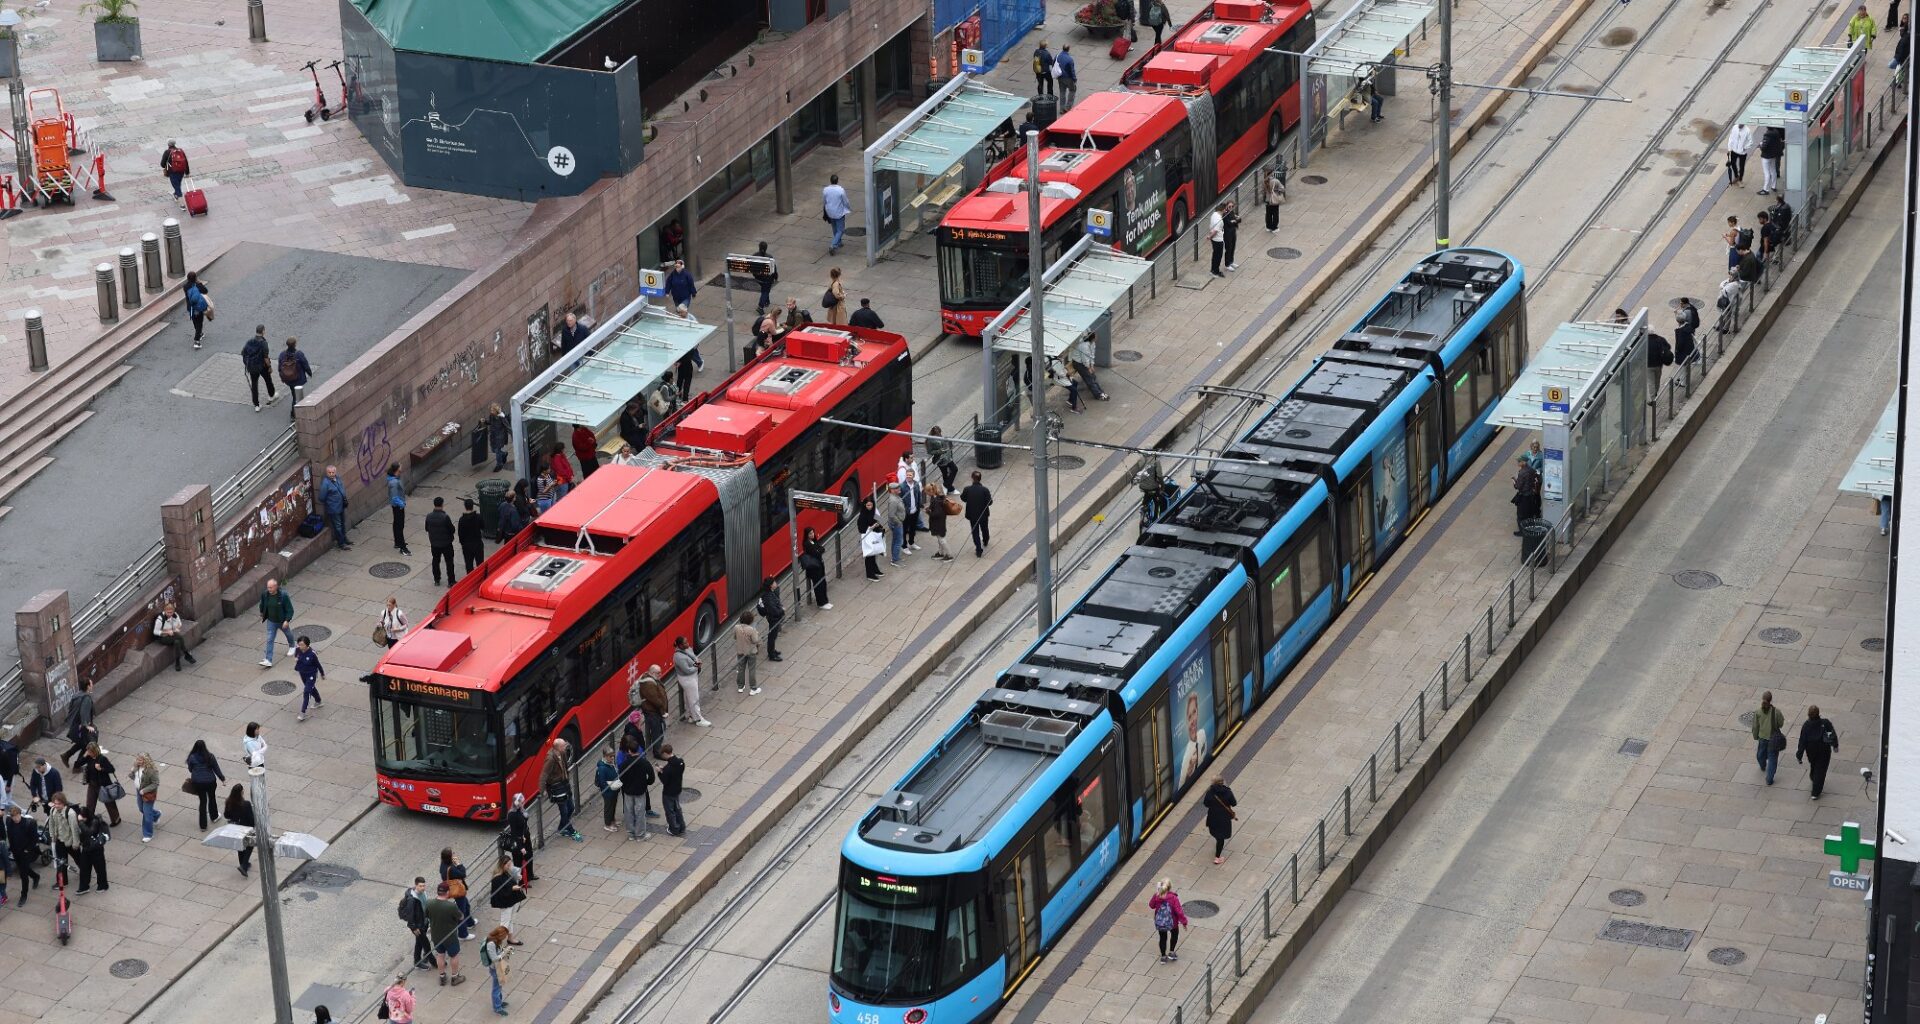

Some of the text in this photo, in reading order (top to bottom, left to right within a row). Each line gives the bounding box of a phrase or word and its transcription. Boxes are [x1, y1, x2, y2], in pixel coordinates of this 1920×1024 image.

[951, 228, 965, 240] 54
[1126, 228, 1137, 245] for
[389, 679, 401, 691] 31
[860, 876, 871, 887] 15
[1832, 877, 1865, 890] OPEN
[856, 1012, 879, 1024] 458
